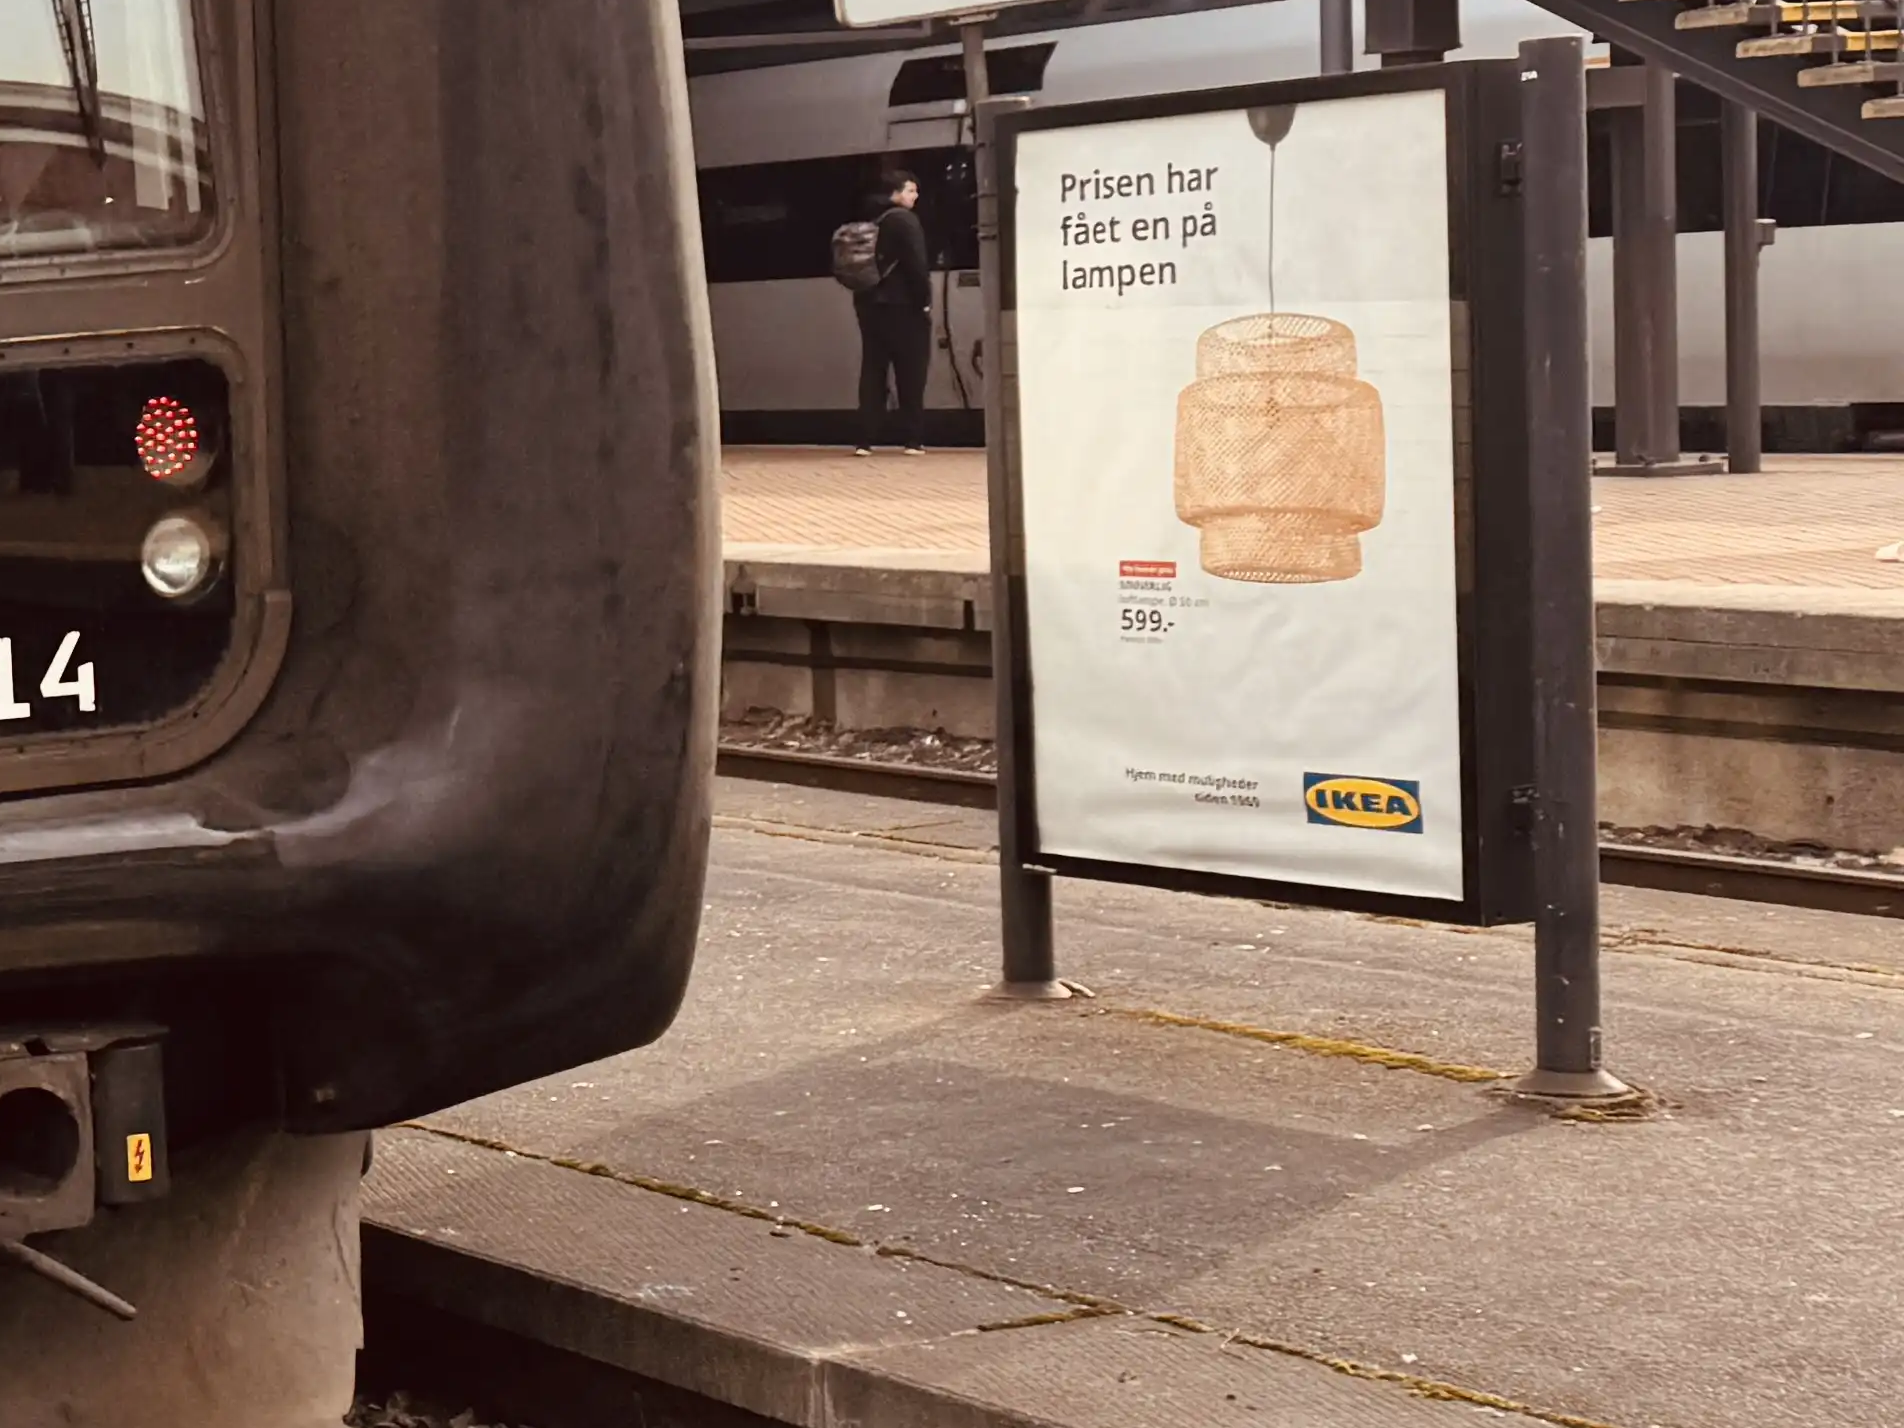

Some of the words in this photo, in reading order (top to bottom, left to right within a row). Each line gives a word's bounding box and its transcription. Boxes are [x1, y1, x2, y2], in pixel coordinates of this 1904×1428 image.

[1060, 169, 1156, 204] Prisen
[1167, 162, 1219, 194] har
[1060, 212, 1122, 247] fået
[1131, 217, 1170, 242] en
[1182, 201, 1218, 249] på
[1062, 260, 1177, 296] lampen
[1121, 608, 1175, 632] 599.-
[1315, 788, 1413, 817] IKEA
